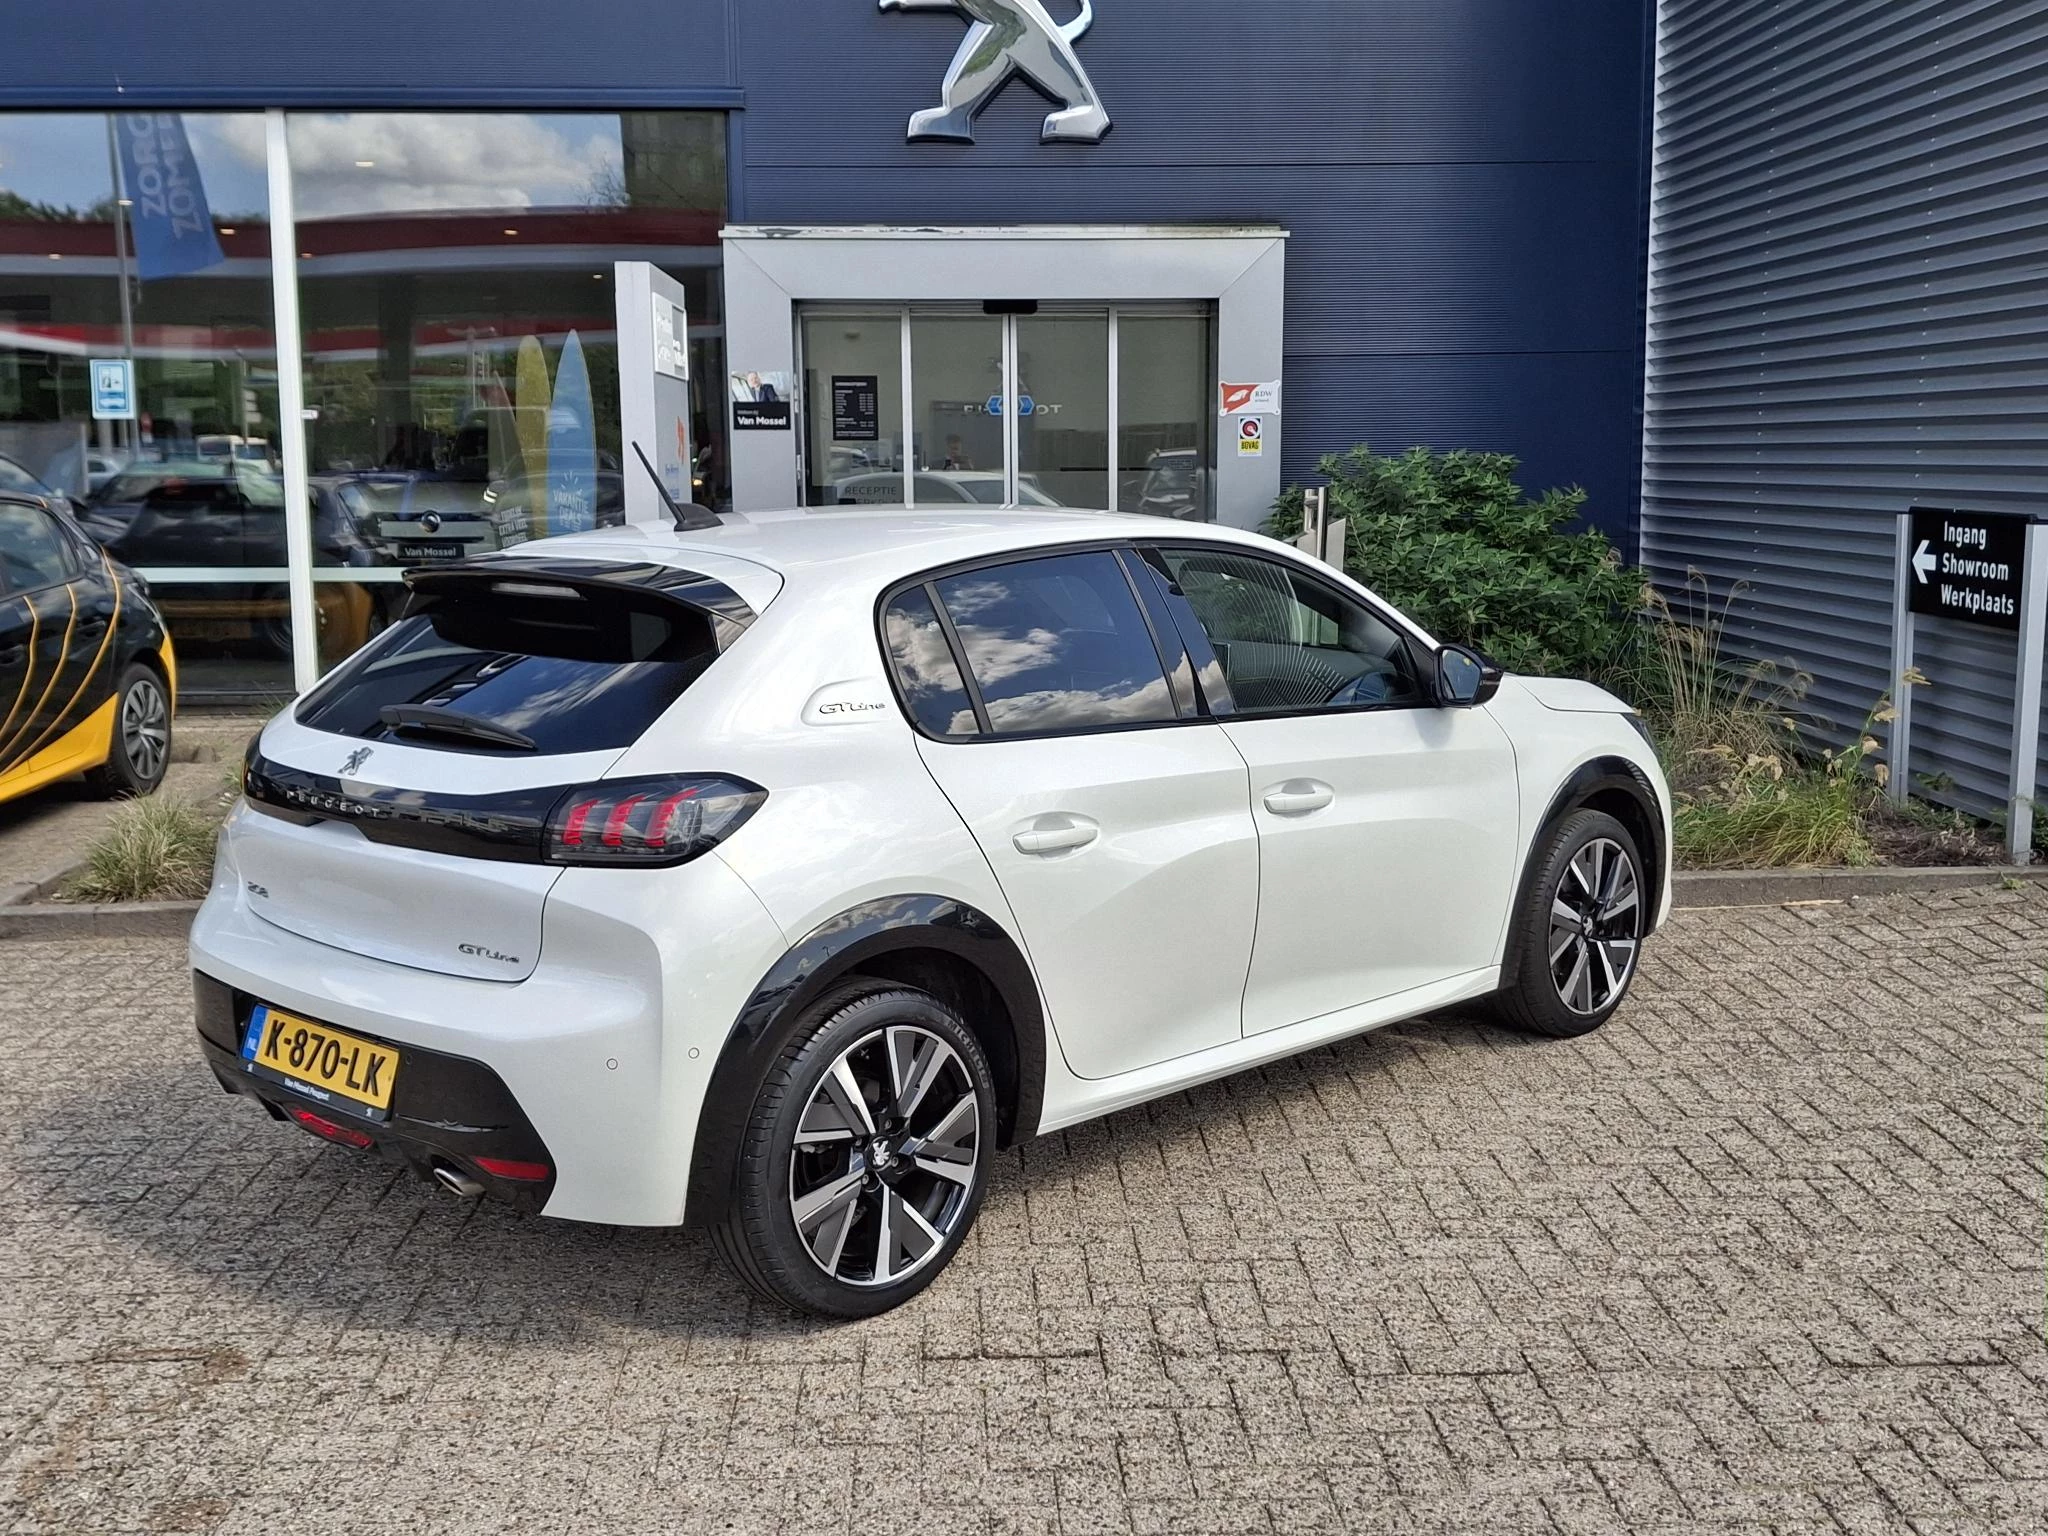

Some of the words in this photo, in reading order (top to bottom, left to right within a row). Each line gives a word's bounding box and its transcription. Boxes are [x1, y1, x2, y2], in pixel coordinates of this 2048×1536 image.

[737, 416, 754, 425] Van
[756, 416, 786, 425] Mossel
[1241, 441, 1259, 450] BOVAG
[553, 488, 590, 514] VAKANTIE
[845, 486, 897, 495] RECEPTIE
[1944, 521, 1986, 550] Ingang
[404, 547, 421, 556] Van
[424, 546, 456, 556] Mossel
[1942, 552, 2009, 580] Showroom
[1941, 584, 2014, 615] Werkplaats
[286, 790, 380, 818] PEUGEOT
[264, 1019, 387, 1097] K-870-LK
[947, 1019, 990, 1089] MICHELIN
